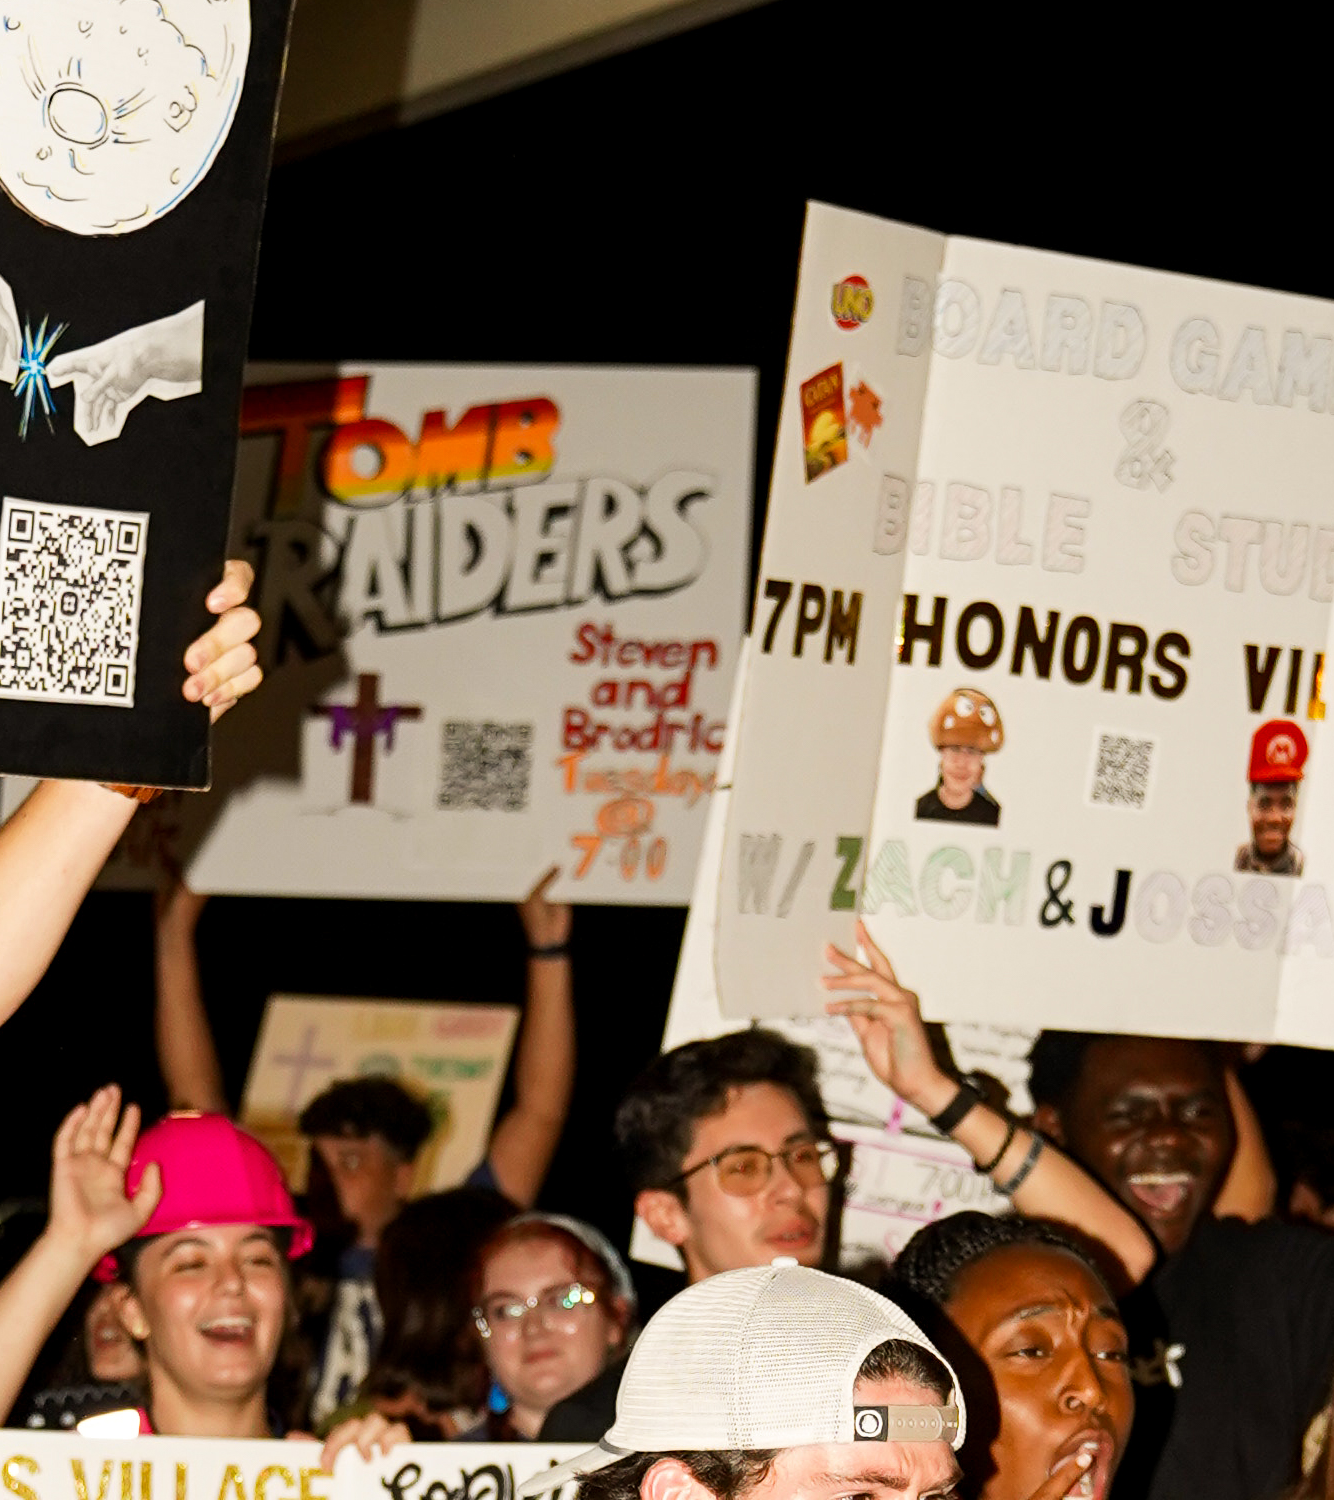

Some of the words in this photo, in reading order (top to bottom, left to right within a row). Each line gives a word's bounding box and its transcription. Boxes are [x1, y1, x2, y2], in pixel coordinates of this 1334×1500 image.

[896, 274, 1145, 380] BOARD
[241, 375, 562, 507] TOMB
[1115, 399, 1176, 491] &
[243, 470, 718, 666] RAIDERS
[874, 475, 1090, 573] BIBLE
[569, 622, 718, 670] Steven
[758, 578, 862, 664] 7PM
[899, 592, 1189, 699] HONORS
[593, 668, 691, 710] and
[829, 835, 1033, 926] ZACH
[1039, 860, 1077, 928] &
